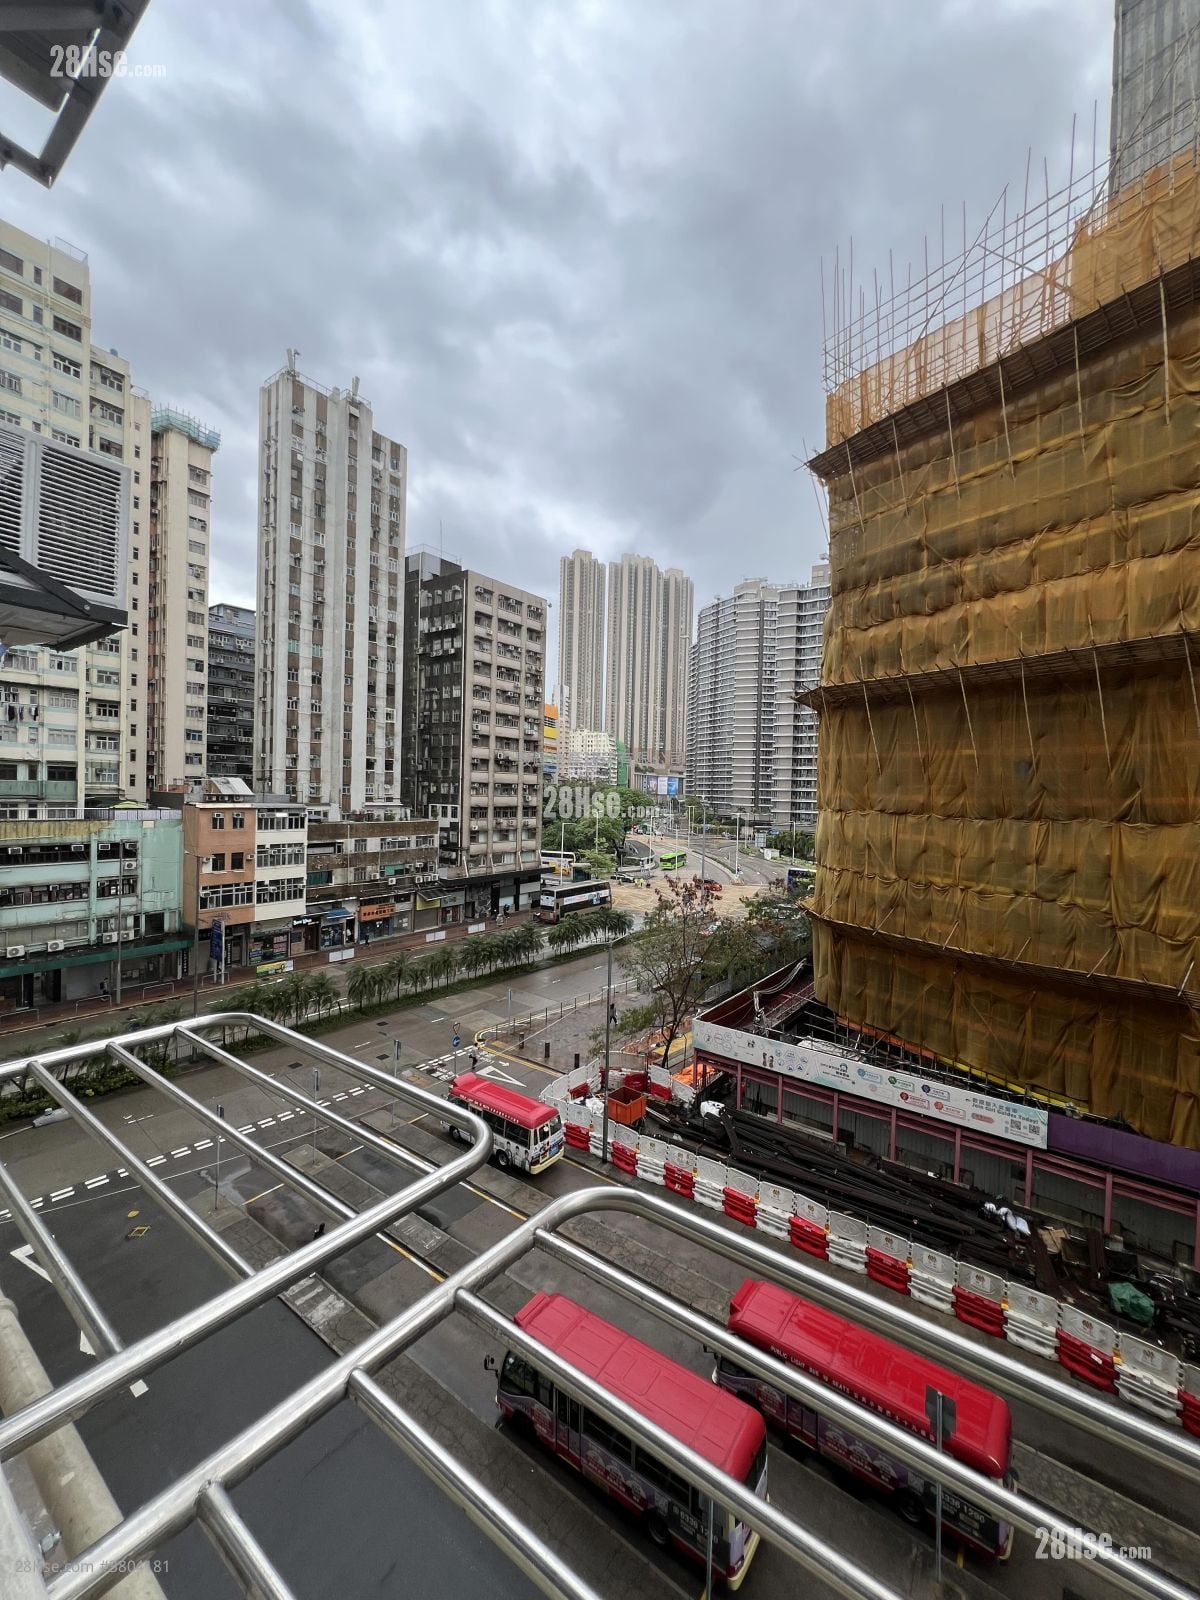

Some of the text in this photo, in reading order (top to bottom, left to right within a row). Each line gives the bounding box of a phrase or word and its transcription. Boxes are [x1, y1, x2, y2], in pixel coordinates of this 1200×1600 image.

[770, 1345, 788, 1359] PUBLIC
[790, 1355, 806, 1368] LIGHT
[832, 1380, 850, 1394] SEATS
